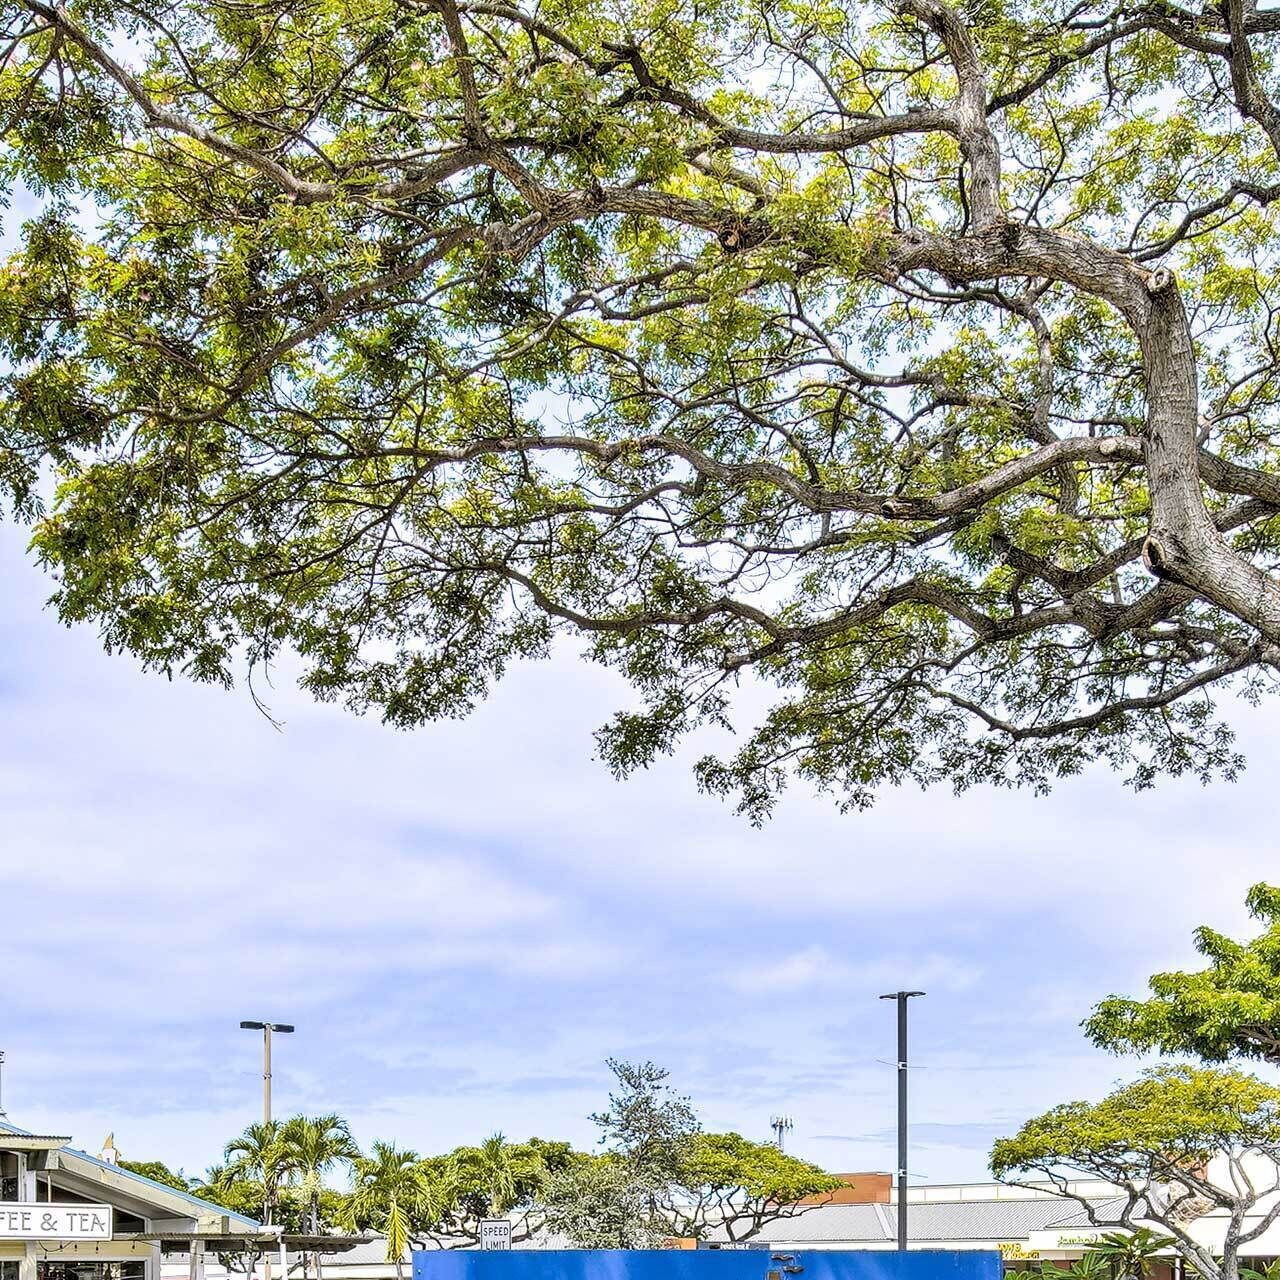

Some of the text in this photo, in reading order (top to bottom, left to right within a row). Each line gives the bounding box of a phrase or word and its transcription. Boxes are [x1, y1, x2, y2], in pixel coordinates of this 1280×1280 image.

[40, 1213, 58, 1232] &
[66, 1213, 105, 1232] TEA
[483, 1227, 509, 1236] SPEED
[486, 1240, 506, 1250] LIMIT
